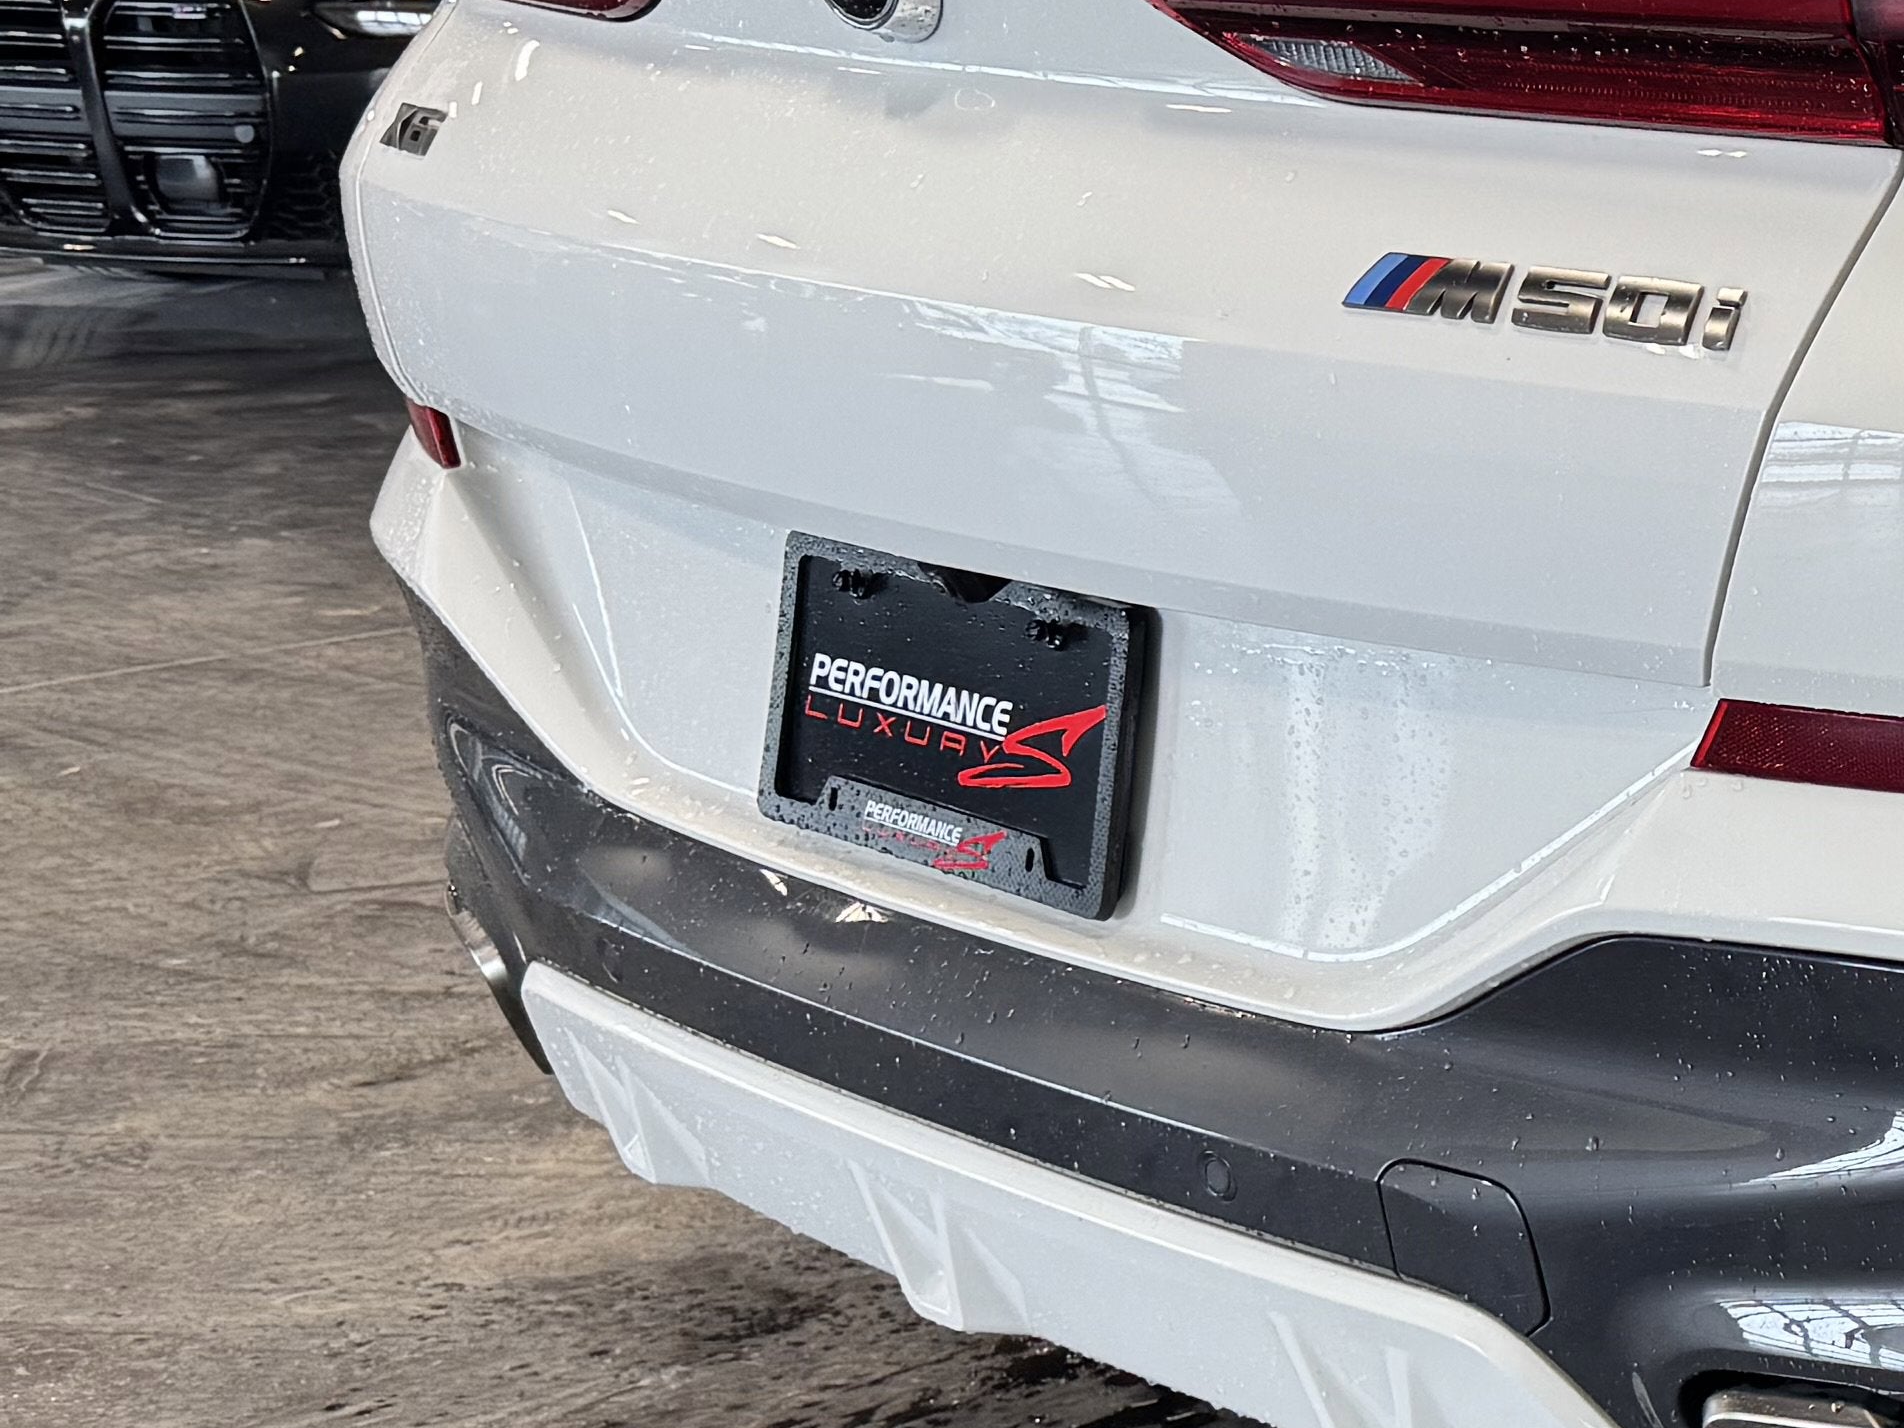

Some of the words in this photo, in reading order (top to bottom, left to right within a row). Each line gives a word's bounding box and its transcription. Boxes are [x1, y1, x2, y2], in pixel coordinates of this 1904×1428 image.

[379, 102, 448, 156] X6
[1402, 257, 1749, 351] M50i
[808, 652, 1014, 735] PERFORMANCE
[804, 694, 1001, 764] LUXURY
[864, 799, 964, 844] PERFORMANCE
